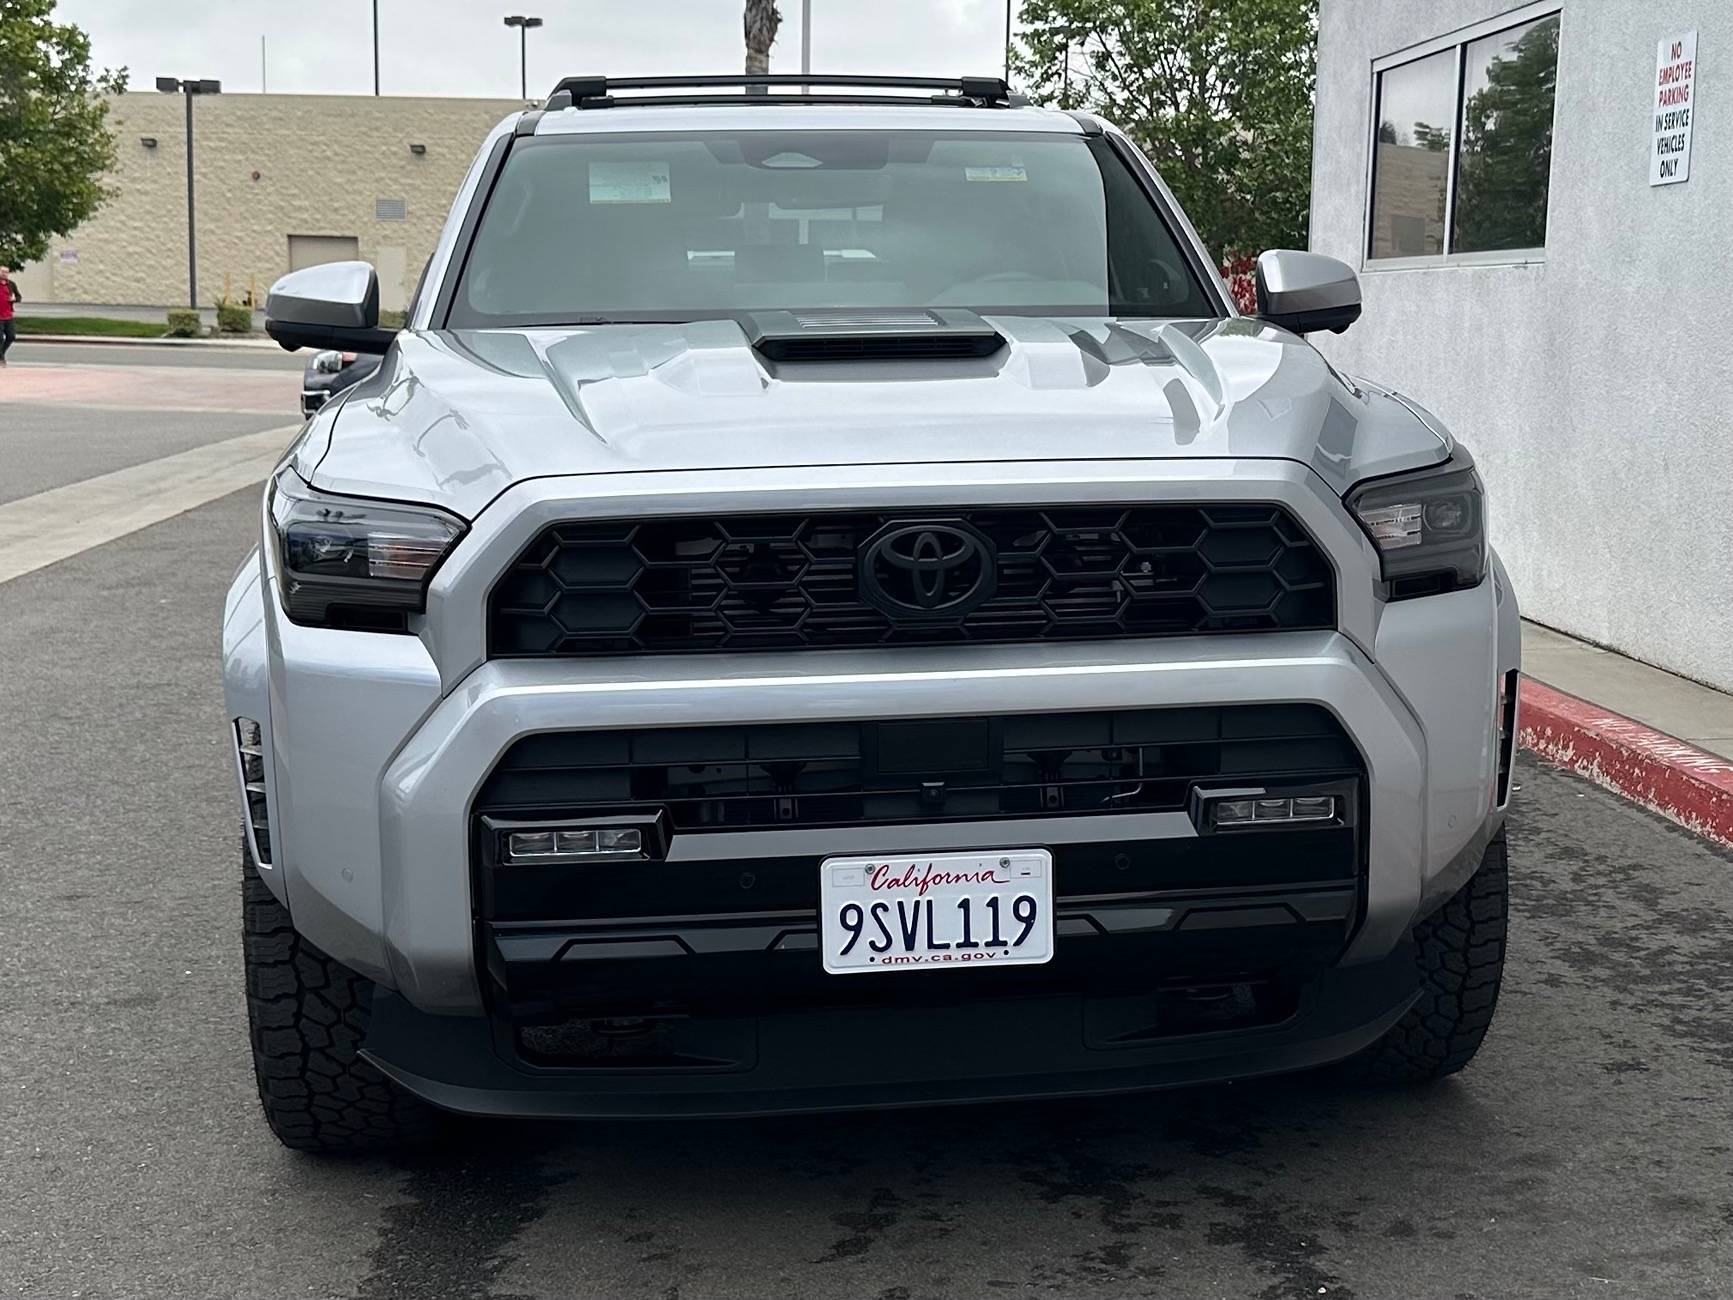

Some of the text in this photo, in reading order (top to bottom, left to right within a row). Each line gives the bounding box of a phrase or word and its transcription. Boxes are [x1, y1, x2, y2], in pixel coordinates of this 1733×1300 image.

[1671, 41, 1682, 61] NO
[1659, 61, 1692, 86] EMPLOYEE
[1659, 85, 1689, 107] PARKING
[1655, 108, 1690, 133] IN SERVICE
[1656, 133, 1685, 156] VEHICLES
[1659, 158, 1679, 178] ONLY
[870, 863, 1010, 896] California
[839, 895, 1037, 956] 9SVL119
[881, 951, 997, 966] dmv.ca.gov
